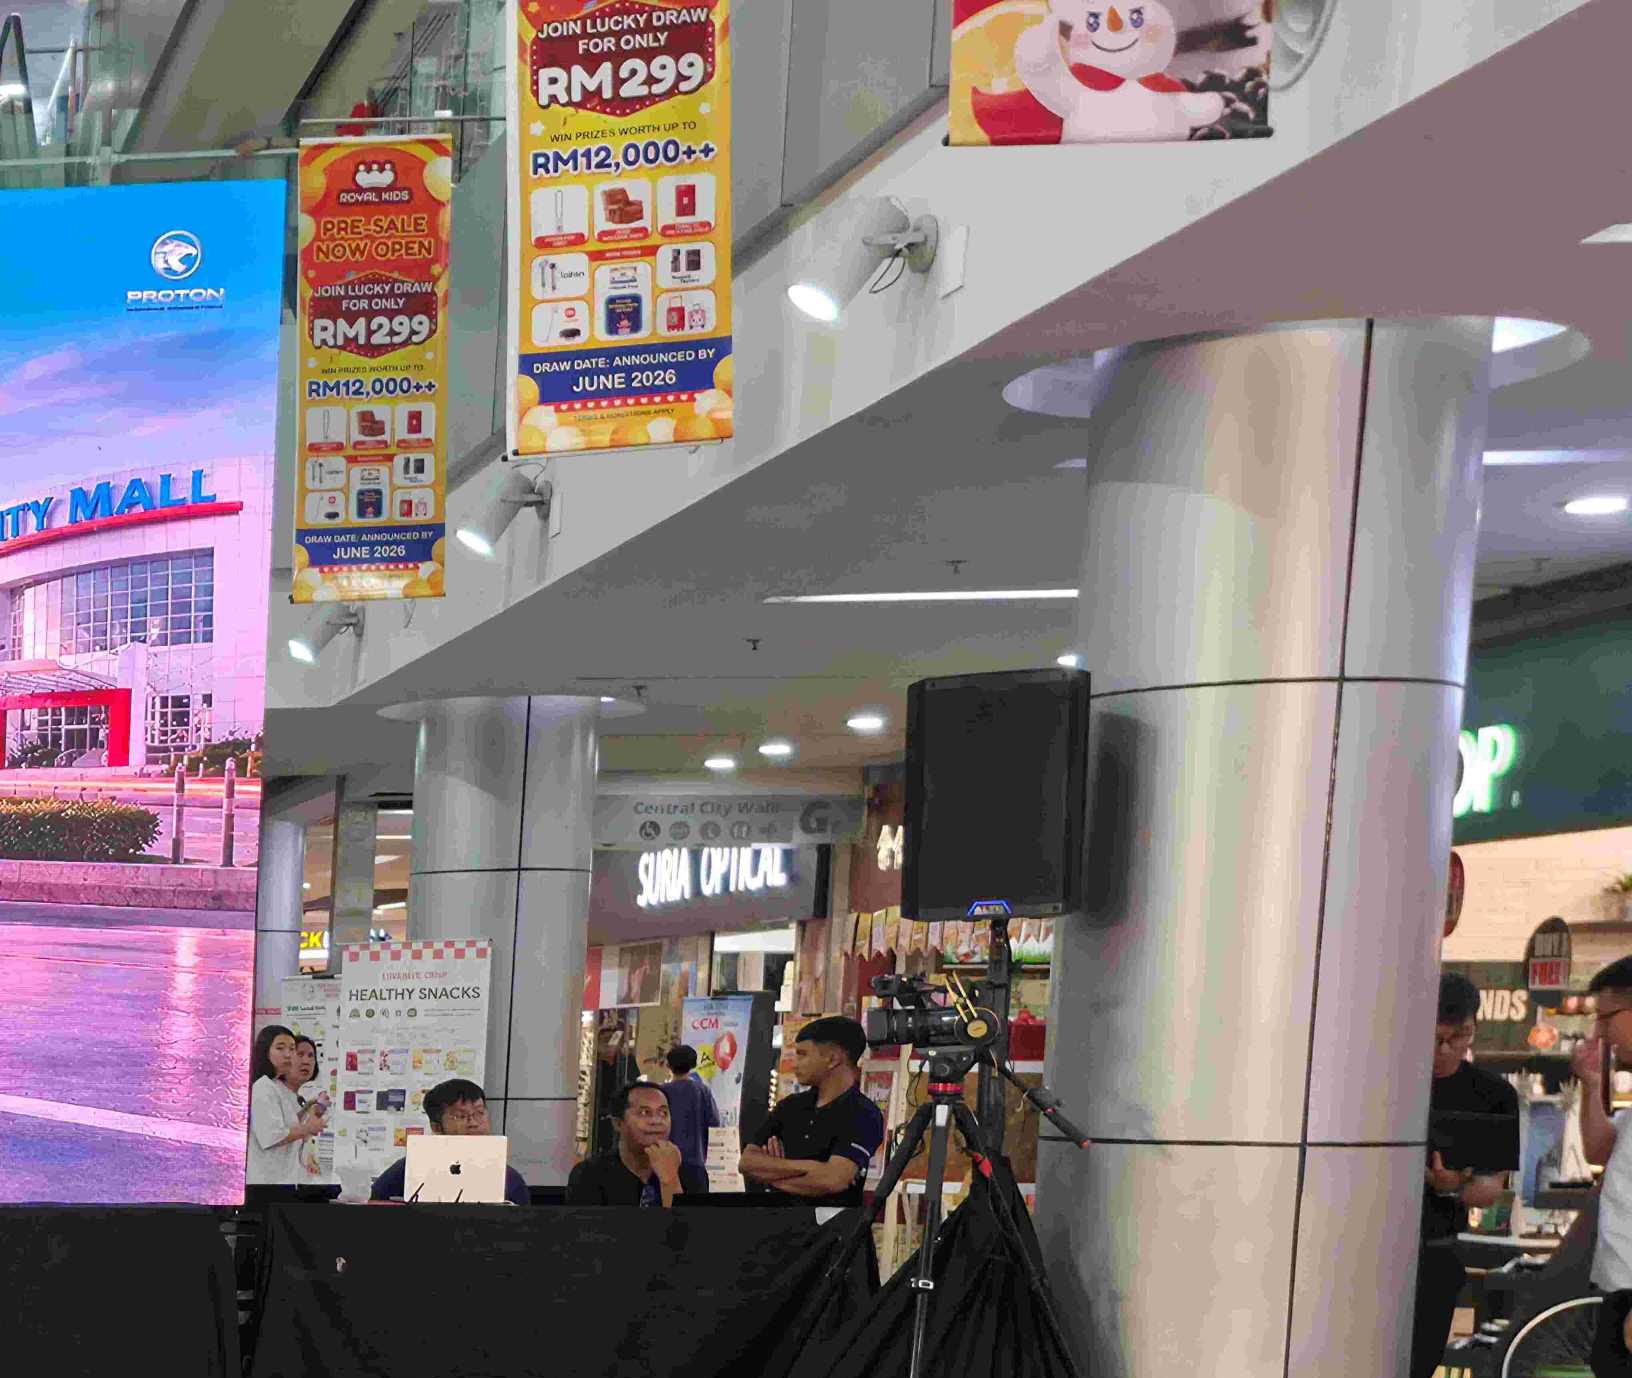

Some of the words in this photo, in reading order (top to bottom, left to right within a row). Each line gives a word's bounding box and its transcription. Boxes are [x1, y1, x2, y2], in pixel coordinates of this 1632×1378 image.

[538, 22, 582, 39] JOIN
[586, 15, 647, 33] LUCKY
[652, 8, 708, 26] DRAW
[578, 38, 616, 54] FOR
[620, 32, 668, 50] ONLY
[550, 132, 572, 143] WIN
[575, 129, 616, 140] PRIZES
[618, 124, 660, 136] WORTH
[663, 122, 679, 132] UP
[683, 120, 697, 130] TO
[531, 138, 716, 177] RM12,000++
[339, 191, 379, 203] ROYAL
[381, 190, 410, 202] KIDS
[321, 214, 428, 237] PRE-SALE
[314, 241, 370, 262] NOW
[374, 238, 433, 259] OPEN
[126, 287, 225, 304] PROTON
[314, 285, 346, 298] JOIN
[347, 282, 391, 296] LUCKY
[394, 281, 433, 294] DRAW
[342, 300, 368, 311] FOR
[371, 298, 406, 310] ONLY
[533, 361, 574, 374] DRAW
[574, 358, 610, 371] DATE:
[613, 351, 695, 367] ANNOUNCED
[698, 348, 716, 360] BY
[307, 377, 437, 399] RM12,000++
[572, 374, 626, 392] JUNE
[631, 370, 677, 387] 2026
[68, 467, 217, 525] MALL
[304, 536, 333, 545] DRAW
[361, 533, 420, 542] ANNOUNCED
[421, 531, 434, 540] BY
[332, 547, 370, 559] JUNE
[374, 545, 406, 558] 2026
[633, 800, 694, 816] Central
[699, 800, 733, 817] City
[799, 801, 833, 835] G
[637, 846, 691, 908] SURIA
[699, 845, 787, 898] OPTICAL
[349, 987, 415, 1001] HEALTHY
[418, 985, 481, 1000] SNACKS
[1476, 988, 1529, 1022] NDS
